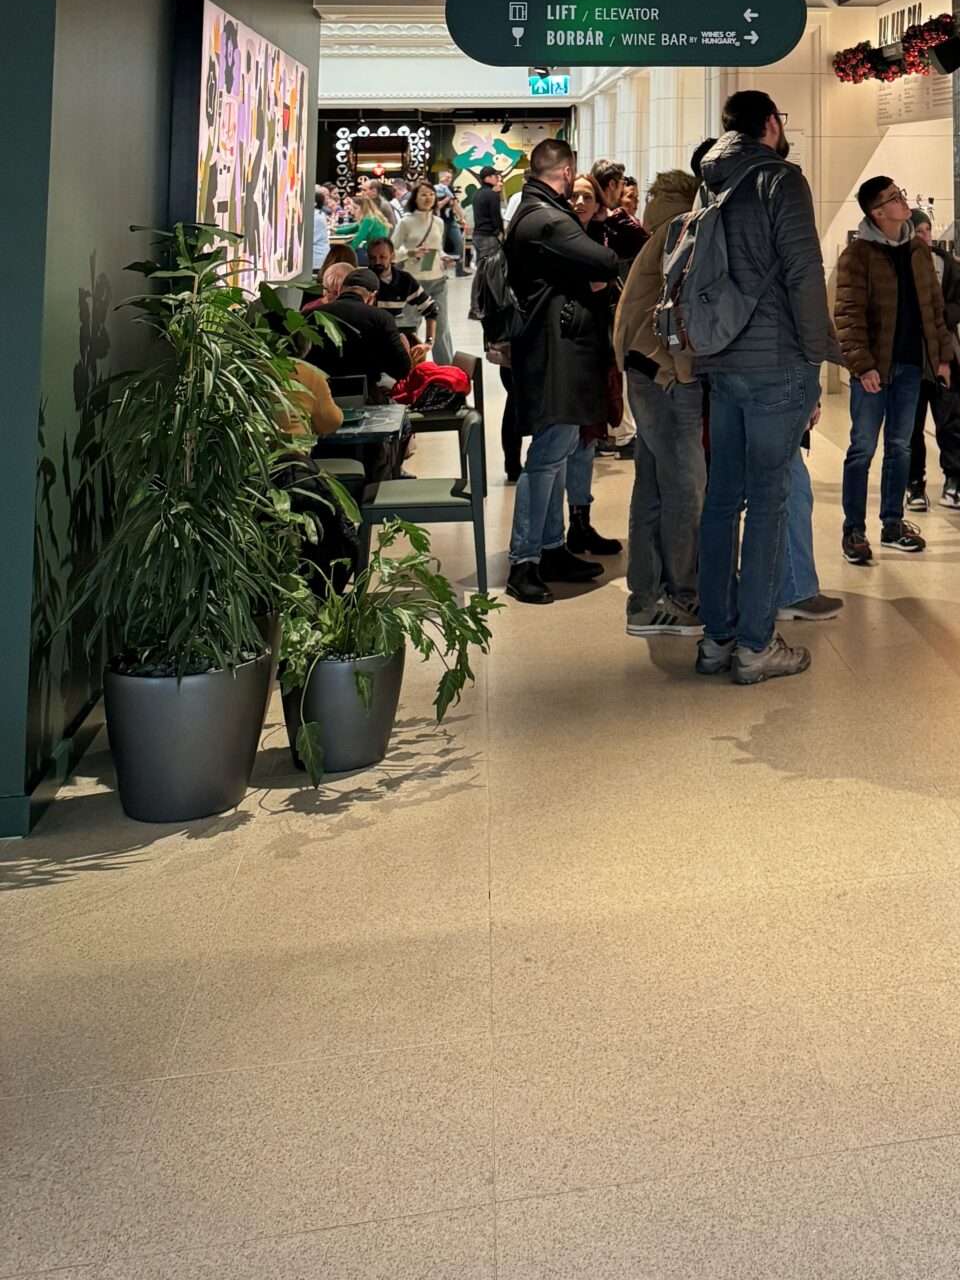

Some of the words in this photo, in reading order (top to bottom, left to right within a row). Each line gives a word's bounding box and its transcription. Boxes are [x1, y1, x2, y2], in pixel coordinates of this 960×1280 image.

[546, 4, 577, 21] LIFT
[594, 7, 660, 21] ELEVATOR
[546, 27, 604, 46] BORBÁR
[621, 32, 656, 46] WINE
[661, 32, 688, 46] BAR
